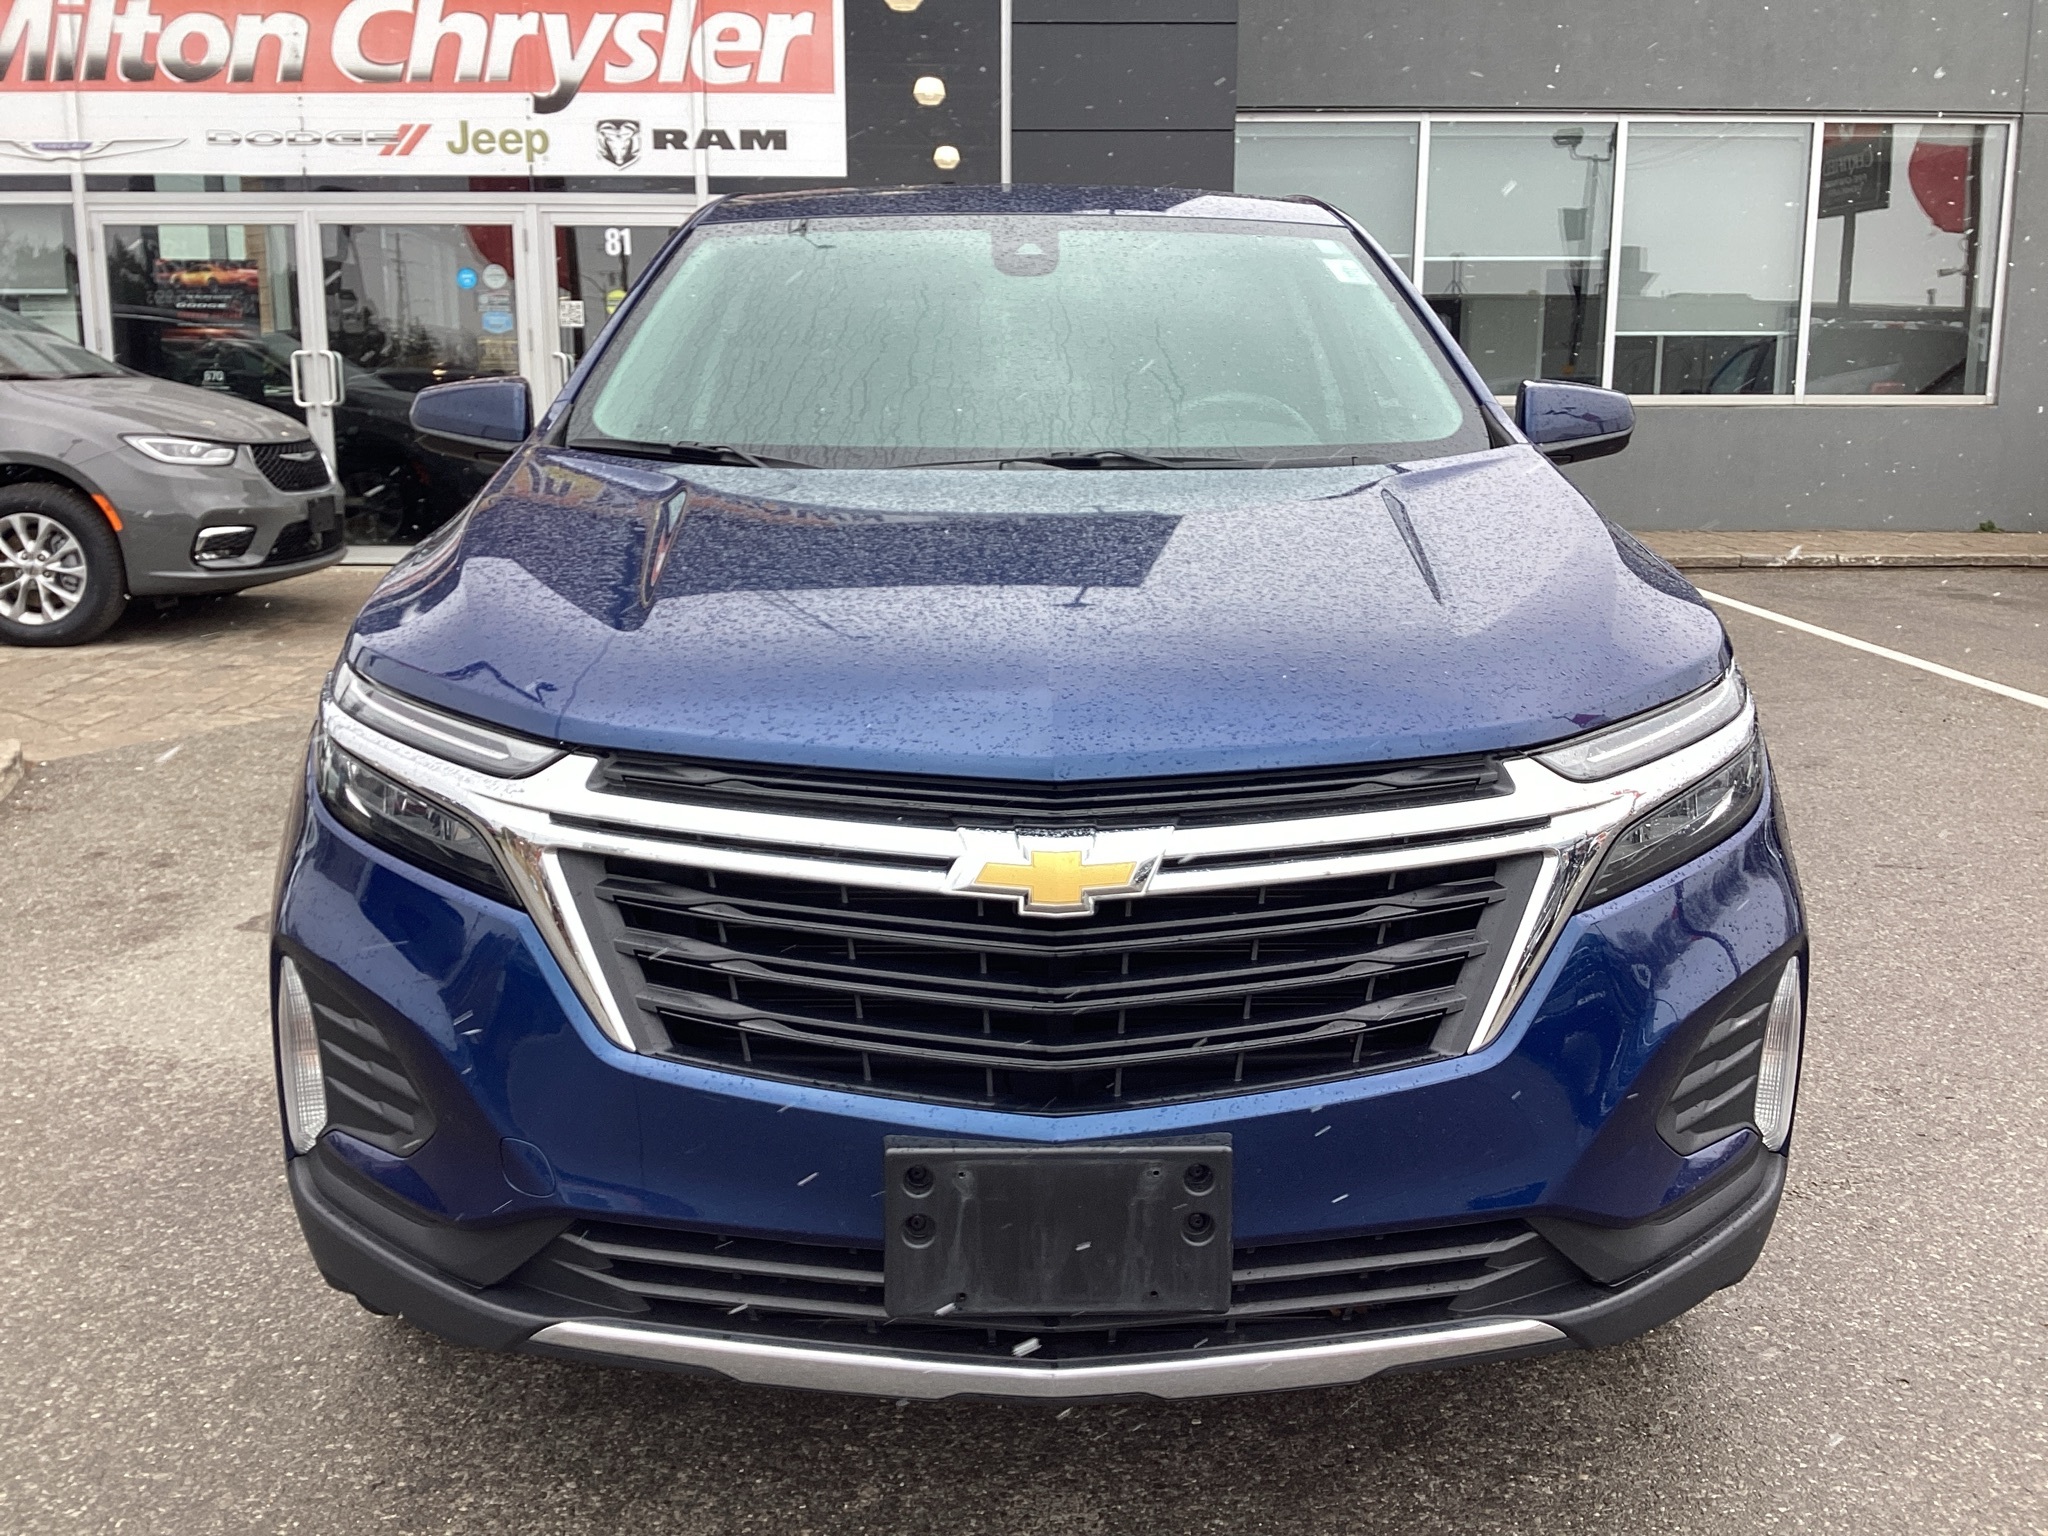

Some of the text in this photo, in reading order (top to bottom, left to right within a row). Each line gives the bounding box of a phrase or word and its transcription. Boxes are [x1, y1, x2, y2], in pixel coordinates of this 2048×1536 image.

[331, 0, 815, 114] Chrysler
[206, 129, 401, 146] DODGE
[446, 120, 550, 162] Jeep
[653, 129, 787, 150] RAM
[604, 228, 632, 256] 81
